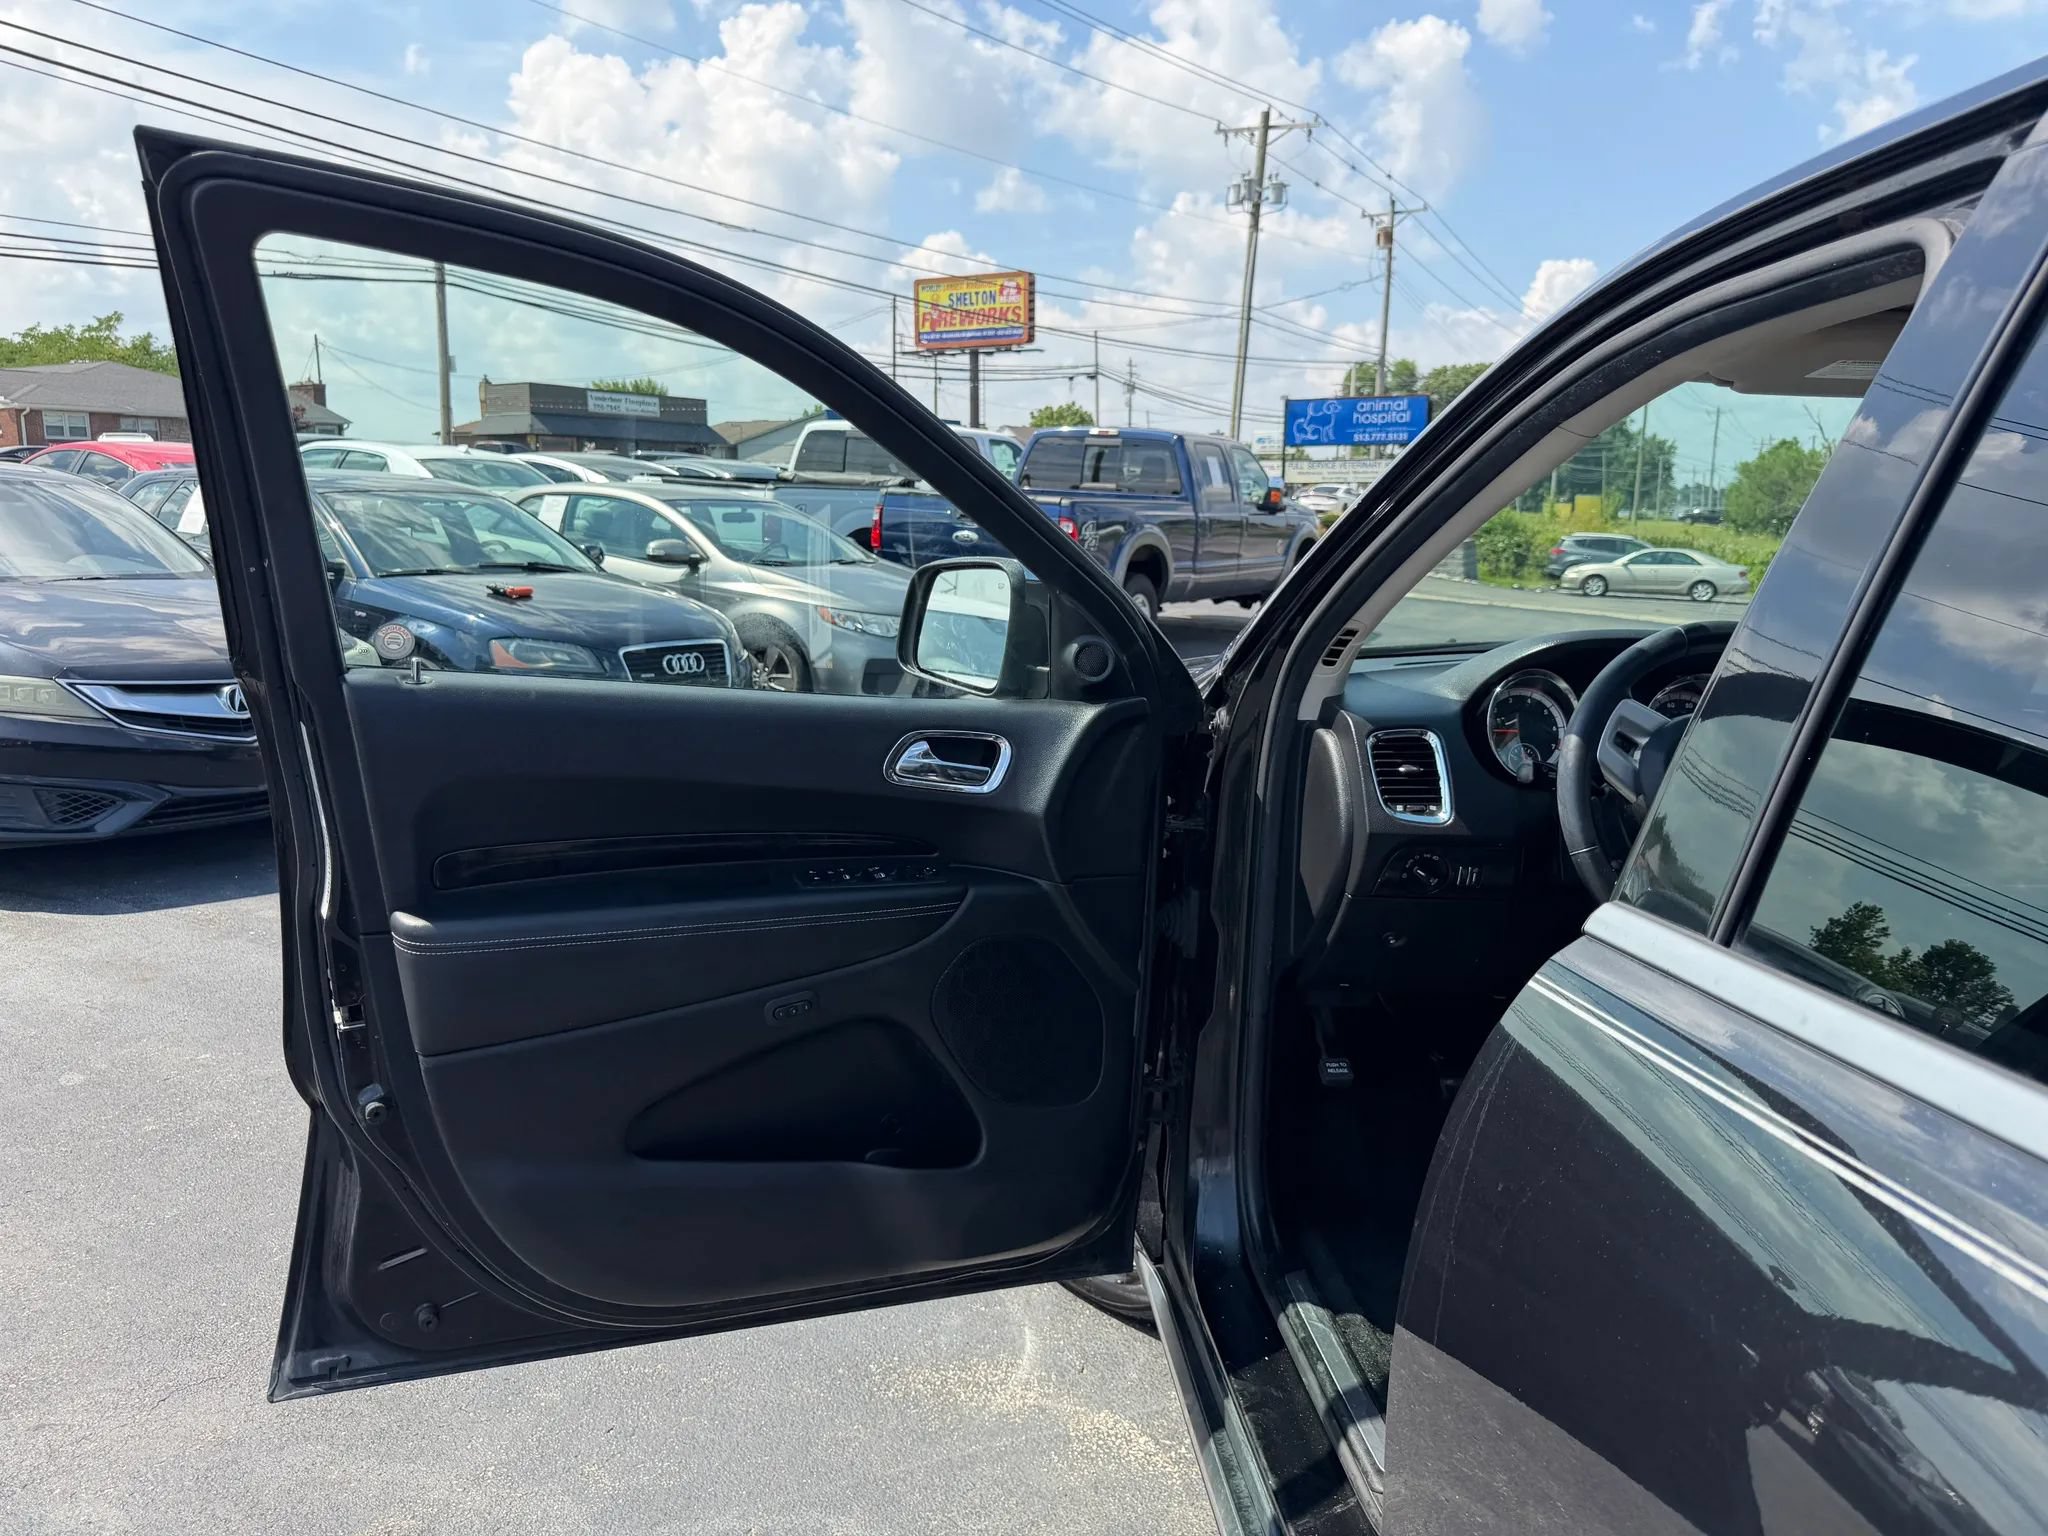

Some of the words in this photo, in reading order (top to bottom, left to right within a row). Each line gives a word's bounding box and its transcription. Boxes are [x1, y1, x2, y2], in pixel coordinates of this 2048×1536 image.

[948, 290, 997, 308] SHELTON
[921, 305, 1022, 331] FIREWORKS
[1357, 398, 1408, 412] animal
[1353, 409, 1412, 425] hospital
